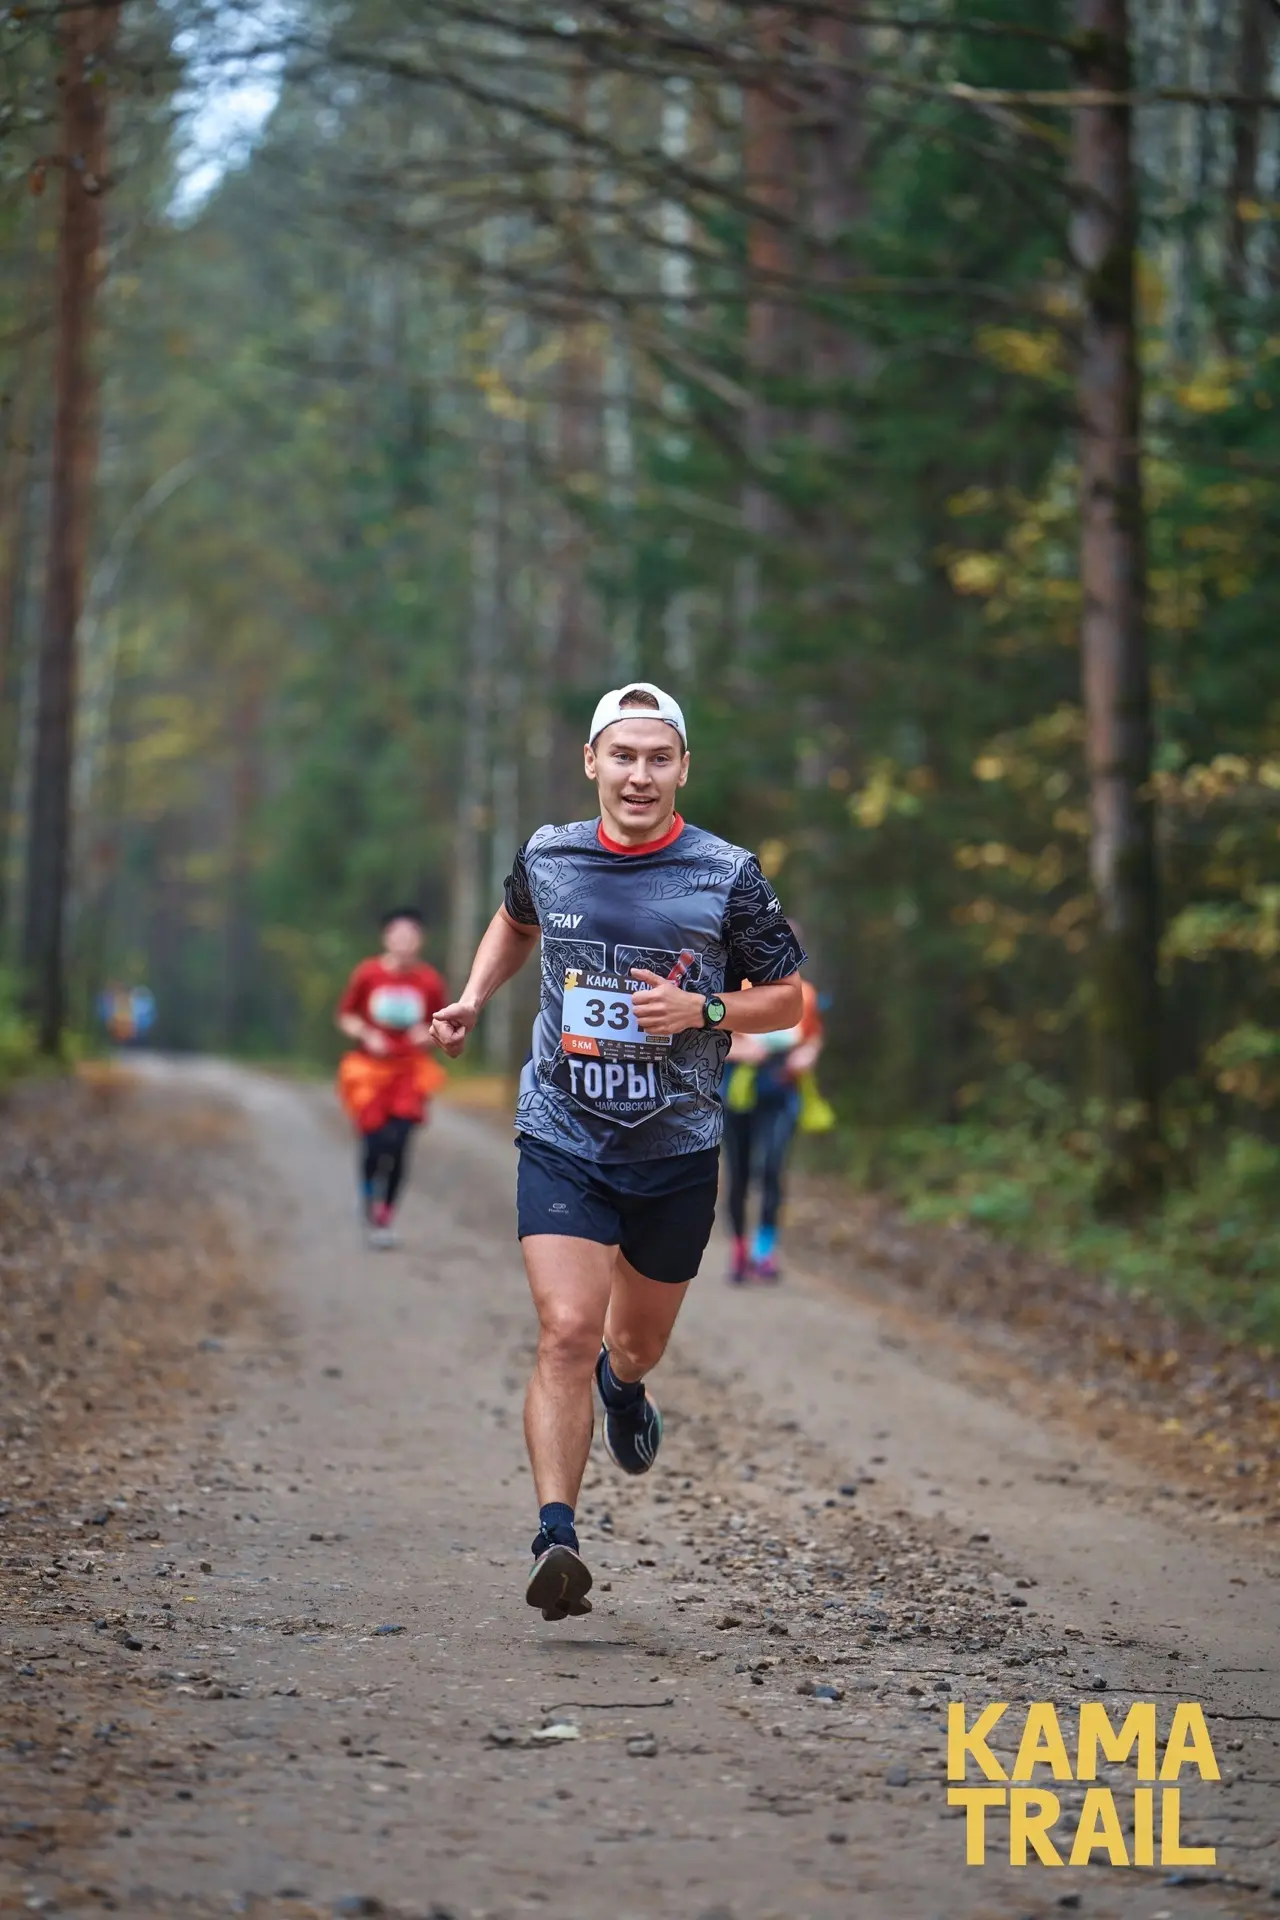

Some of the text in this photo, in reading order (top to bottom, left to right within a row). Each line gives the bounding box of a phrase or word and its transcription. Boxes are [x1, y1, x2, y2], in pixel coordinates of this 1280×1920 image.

[586, 974, 653, 991] KAMA TRAI
[584, 999, 644, 1032] 33
[567, 1059, 656, 1099] ГОРЫ
[595, 1099, 656, 1111] ЧАЙКОВСКИЙ
